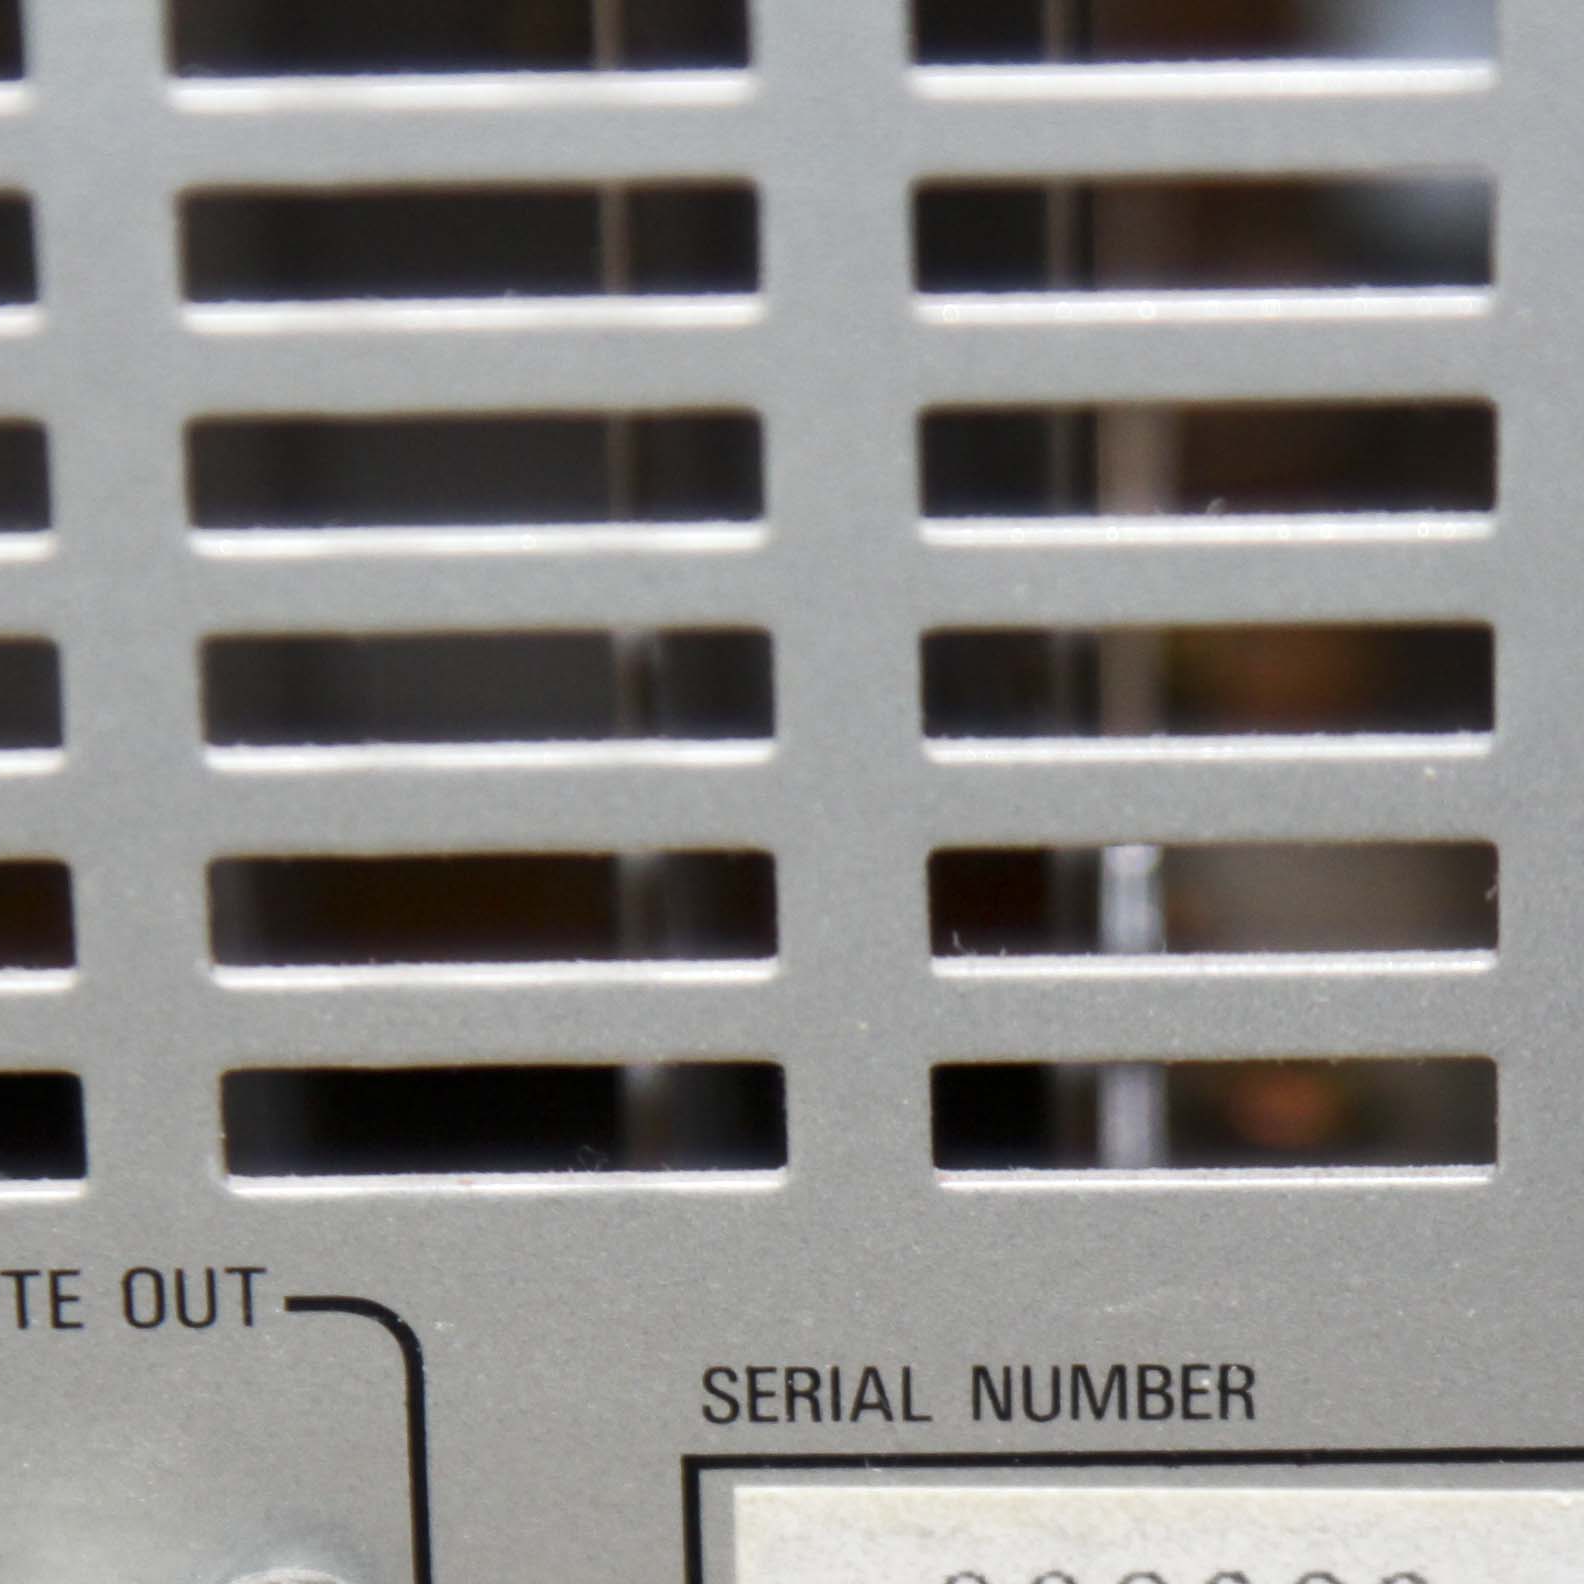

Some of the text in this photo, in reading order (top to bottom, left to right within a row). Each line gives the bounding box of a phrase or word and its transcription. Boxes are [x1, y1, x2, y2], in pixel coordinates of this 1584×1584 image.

[120, 1265, 267, 1331] OUT
[701, 1362, 1256, 1426] SERIAL NUMBER
